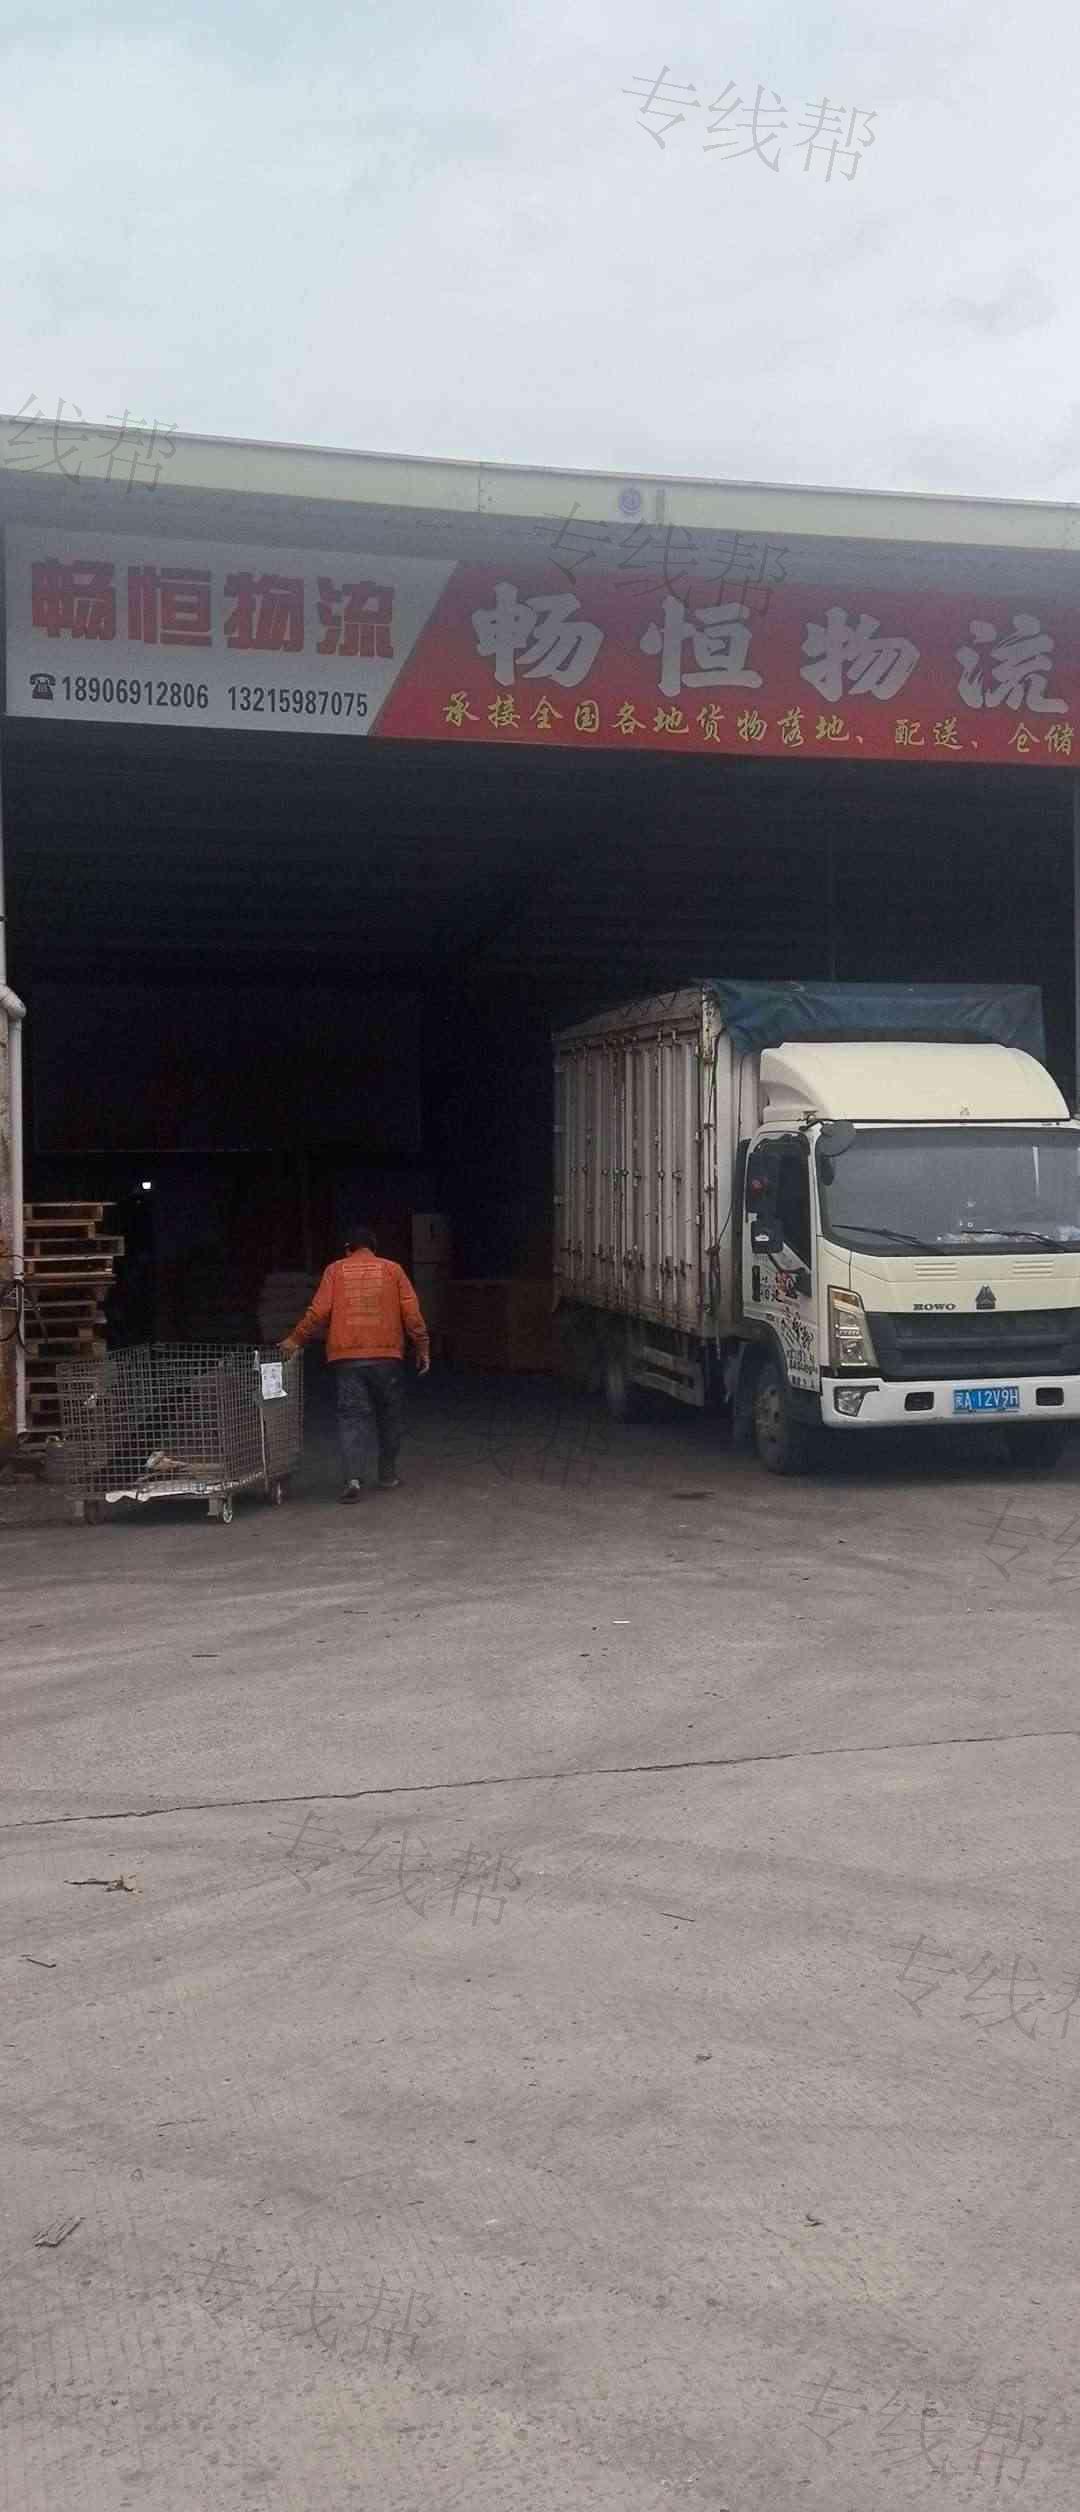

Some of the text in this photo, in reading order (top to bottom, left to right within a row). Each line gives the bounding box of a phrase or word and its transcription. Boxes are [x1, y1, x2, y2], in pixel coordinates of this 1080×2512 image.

[31, 558, 395, 658] 畅恒物流
[470, 581, 1068, 714] 畅恒物流
[62, 675, 368, 717] 18906912806 13215987075
